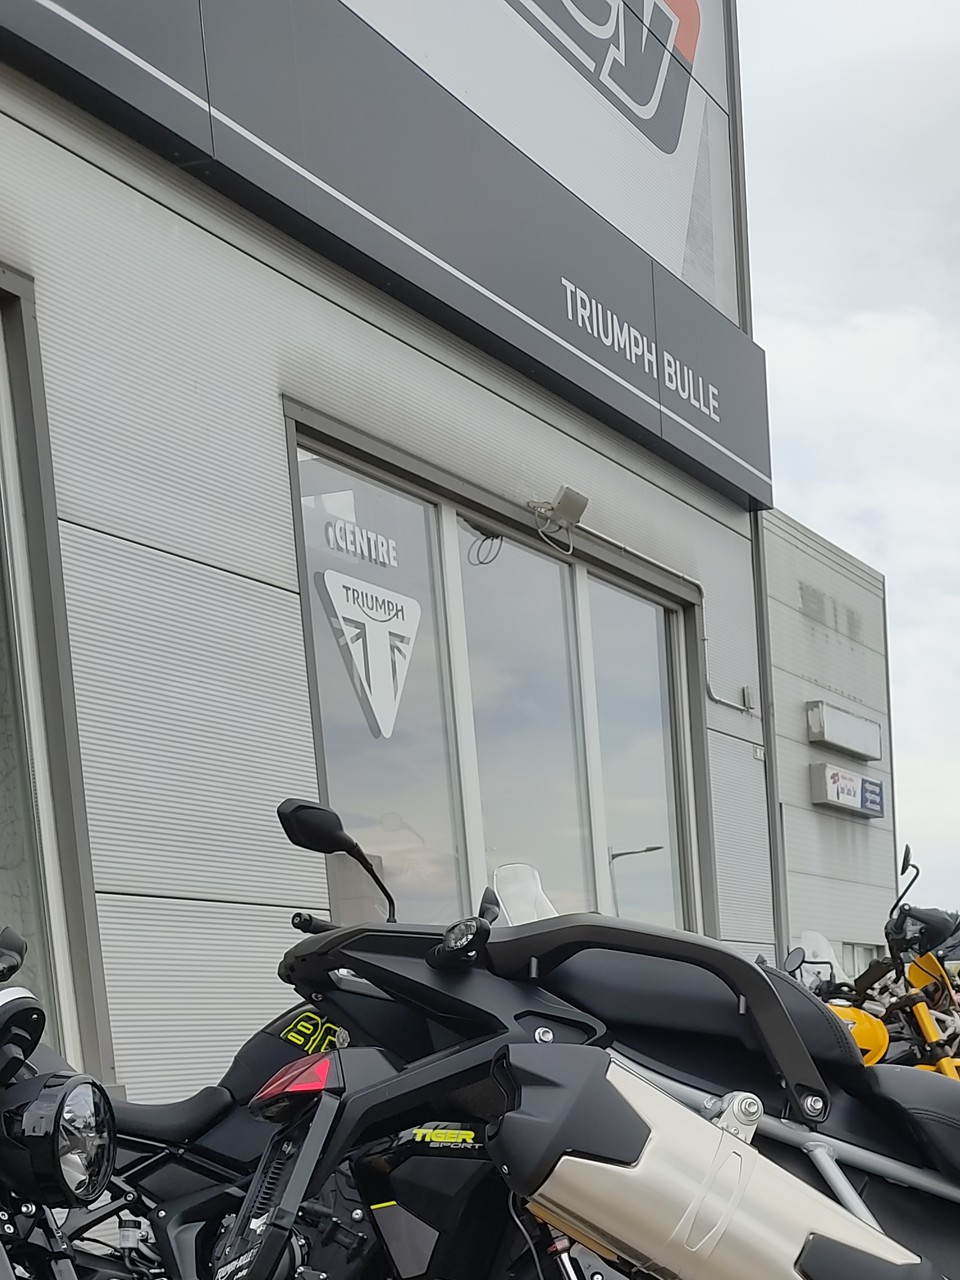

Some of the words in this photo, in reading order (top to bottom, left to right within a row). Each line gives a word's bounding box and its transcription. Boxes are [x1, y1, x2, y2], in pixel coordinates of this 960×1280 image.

[561, 276, 658, 380] TRIUMPH
[663, 350, 721, 423] BULLE
[335, 519, 398, 568] CENTRE
[342, 584, 405, 622] TRIUMPH
[412, 1128, 475, 1144] TIGER
[429, 1142, 484, 1150] SPORT
